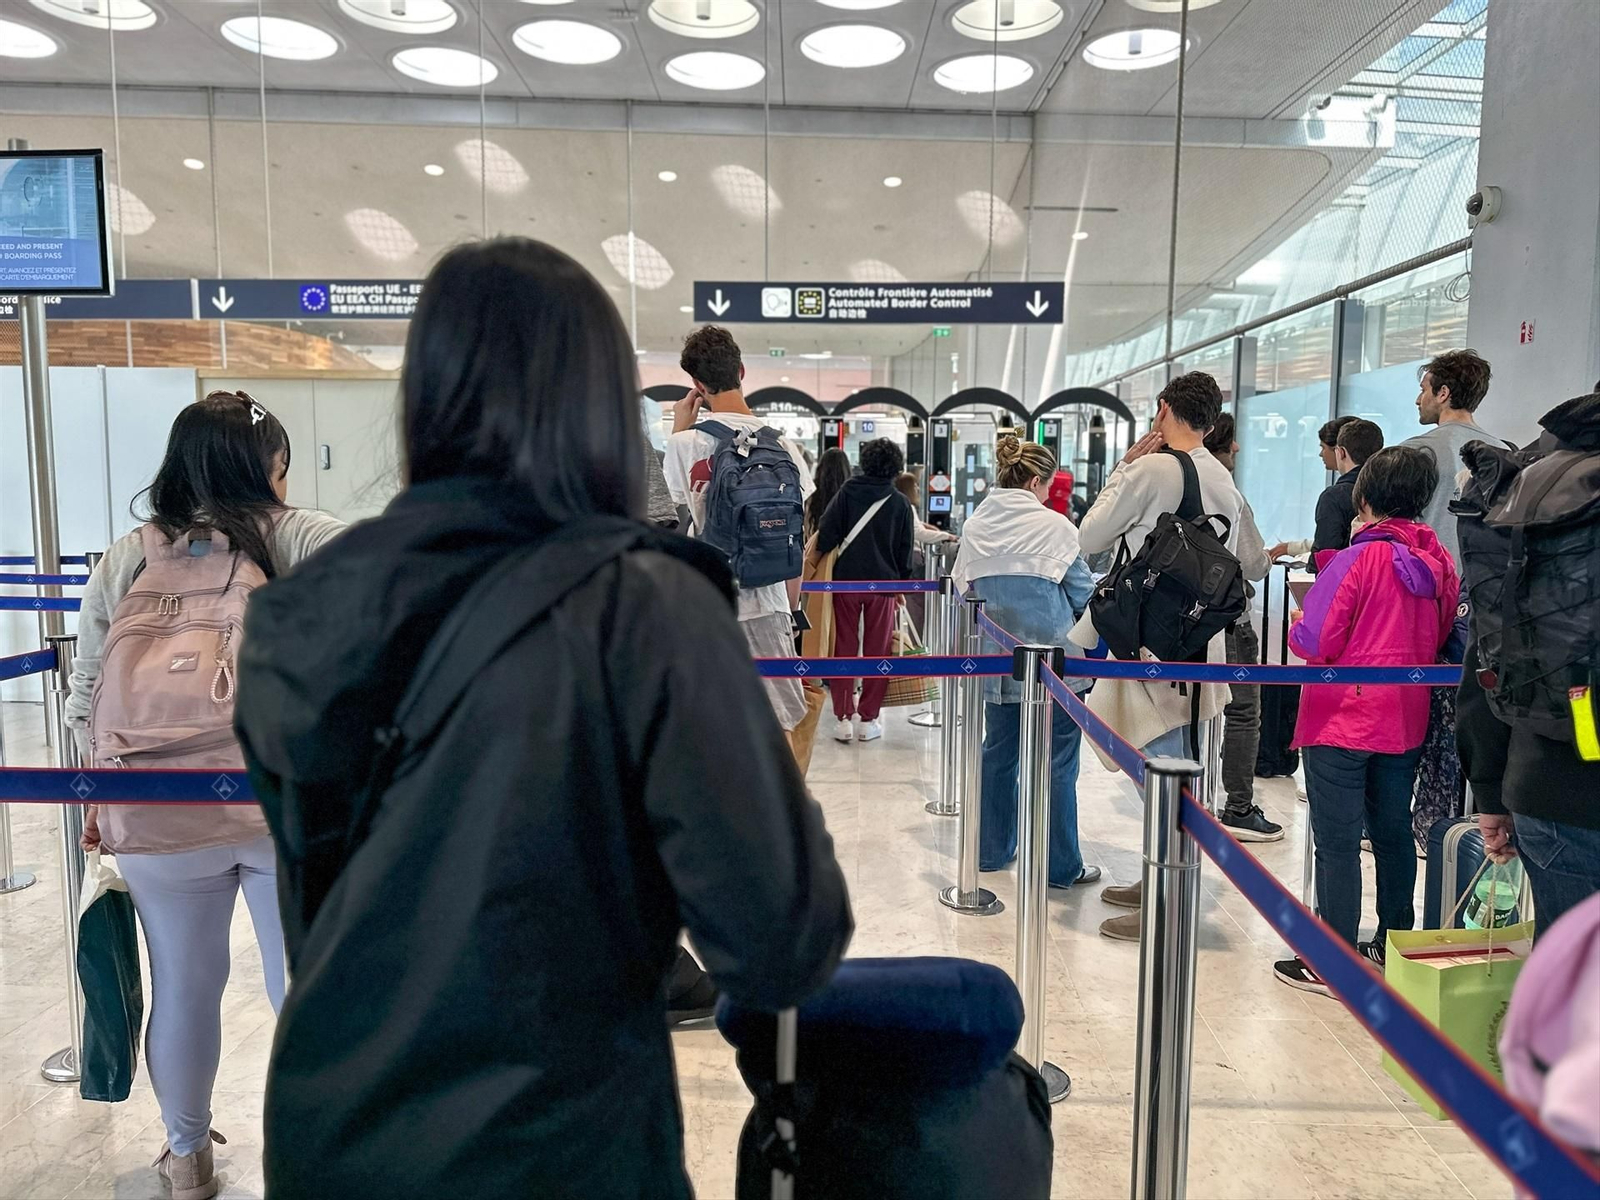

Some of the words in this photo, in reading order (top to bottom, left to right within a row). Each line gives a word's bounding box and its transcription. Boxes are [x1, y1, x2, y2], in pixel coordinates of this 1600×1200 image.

[4, 252, 43, 260] BOARDING
[44, 252, 63, 260] PASS
[329, 284, 384, 295] Passeports
[385, 284, 401, 294] UE
[409, 284, 424, 294] EE
[828, 287, 875, 298] Contrôle
[877, 287, 928, 298] Frontière
[929, 287, 993, 298] Automatisé
[330, 294, 345, 304] EU
[346, 294, 367, 304] EEA
[368, 294, 383, 304] CH
[828, 298, 889, 308] Automated
[890, 298, 928, 308] Border
[930, 298, 972, 308] Control
[863, 422, 874, 432] 10
